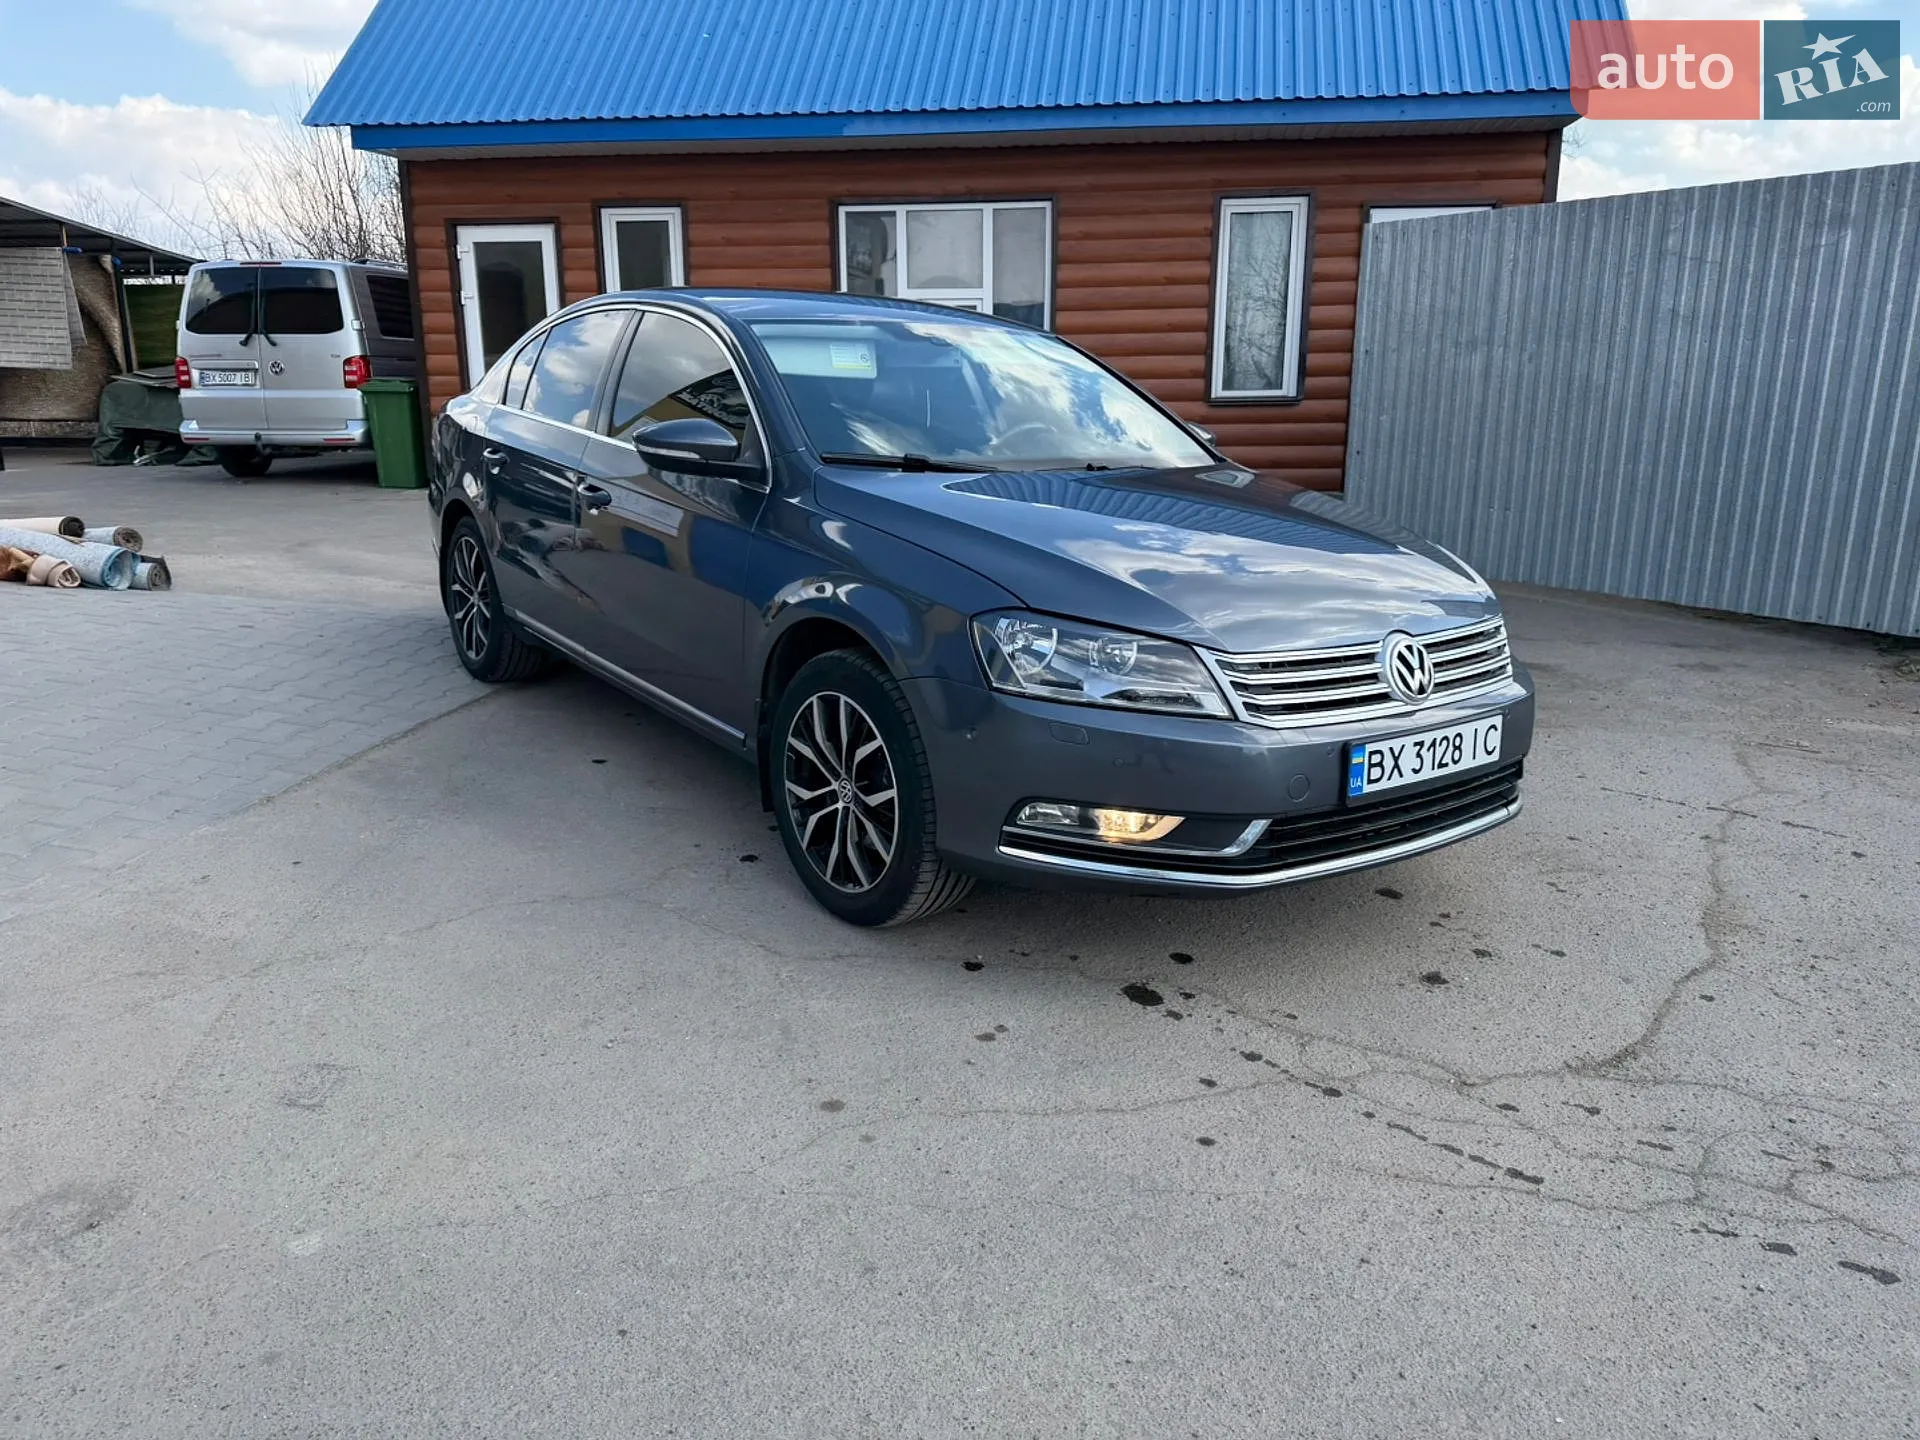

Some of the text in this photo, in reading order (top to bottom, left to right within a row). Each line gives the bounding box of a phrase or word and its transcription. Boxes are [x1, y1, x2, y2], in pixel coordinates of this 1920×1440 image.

[1367, 723, 1498, 785] BX 3128 IC
[1350, 775, 1363, 788] UA
